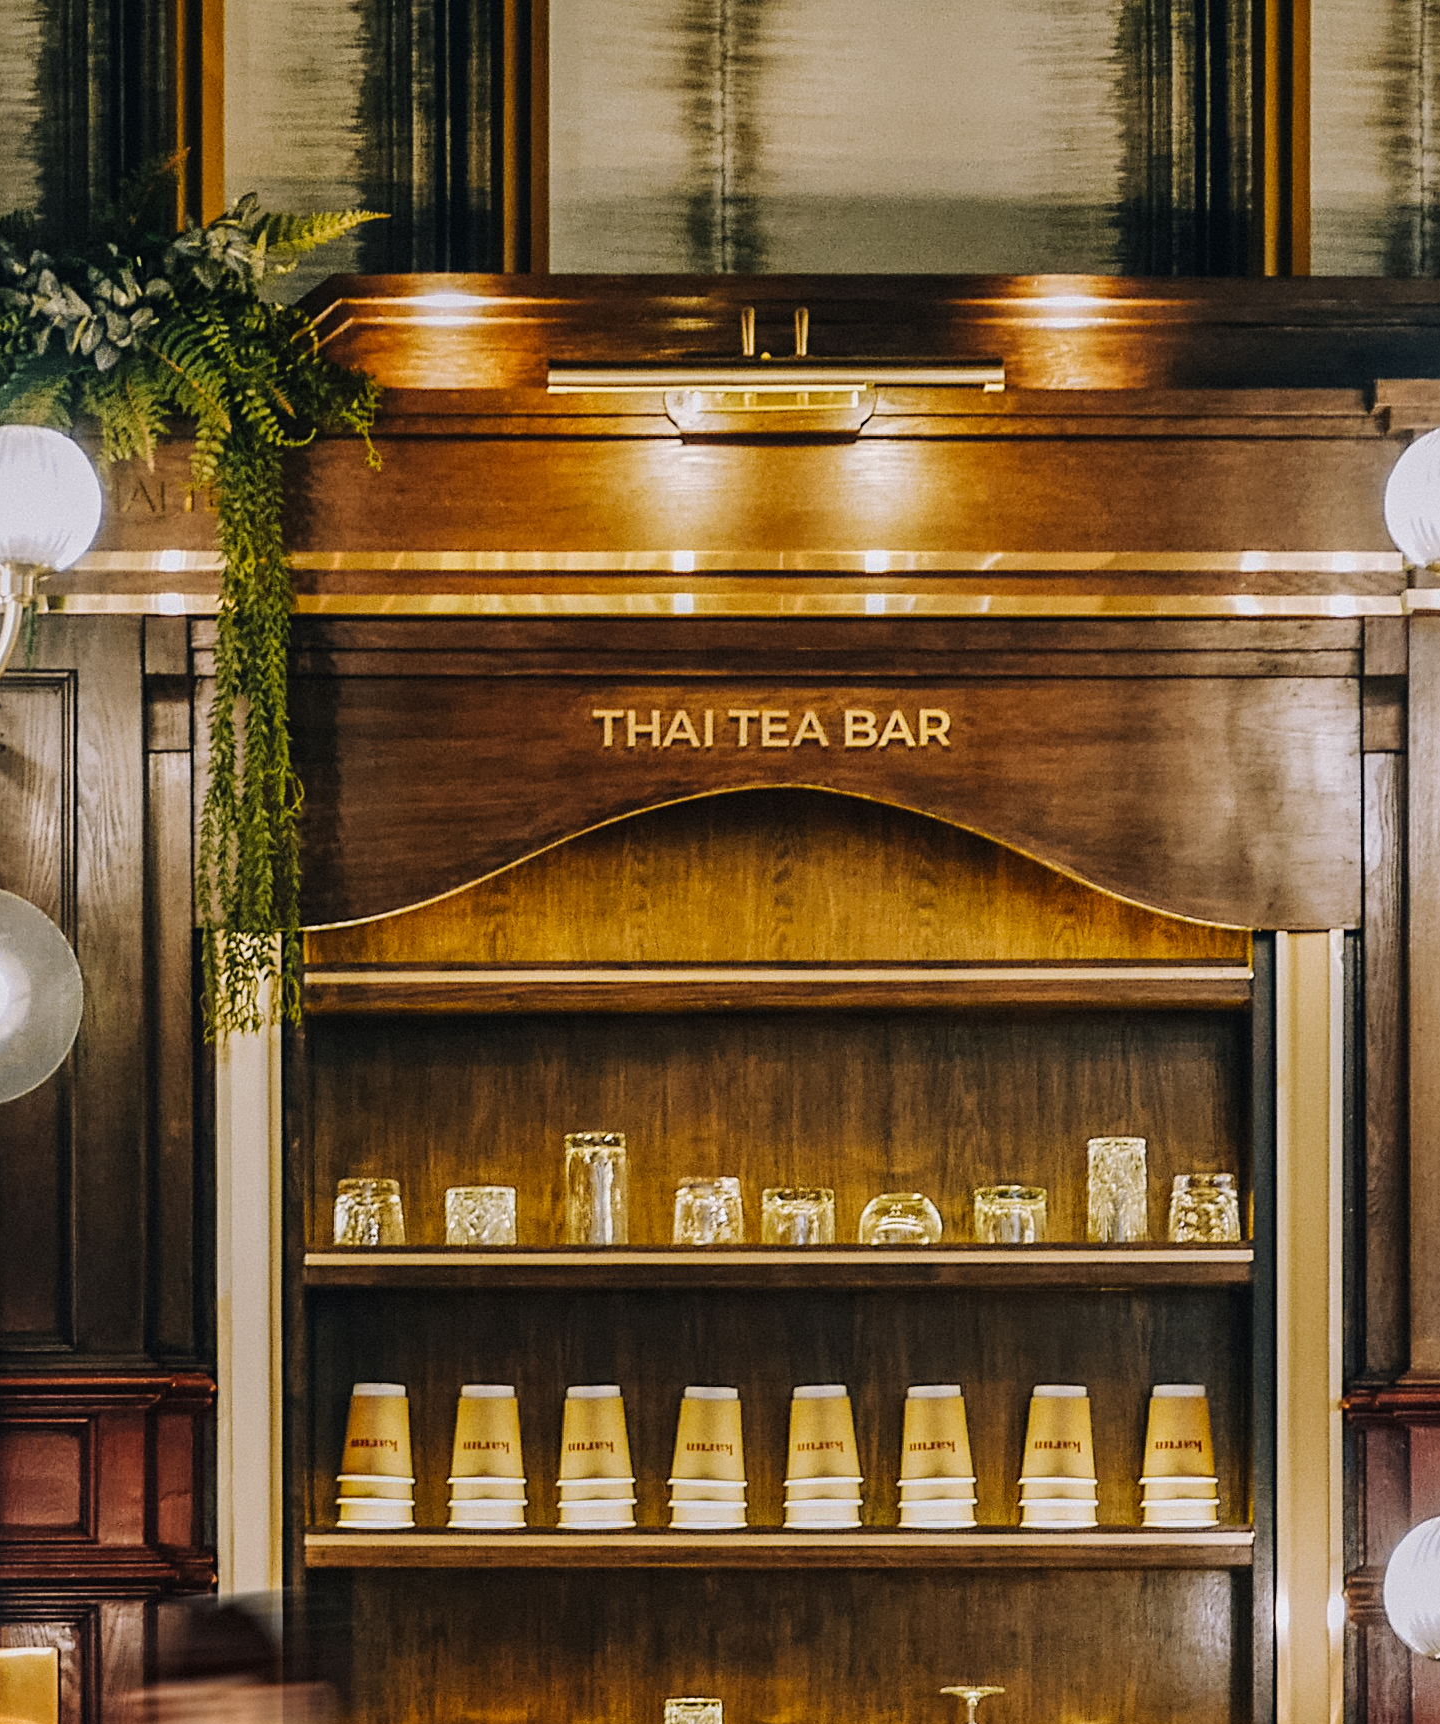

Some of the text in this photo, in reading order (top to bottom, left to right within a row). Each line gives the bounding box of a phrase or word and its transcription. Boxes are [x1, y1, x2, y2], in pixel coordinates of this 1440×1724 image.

[593, 709, 952, 748] THAI TEA BAR
